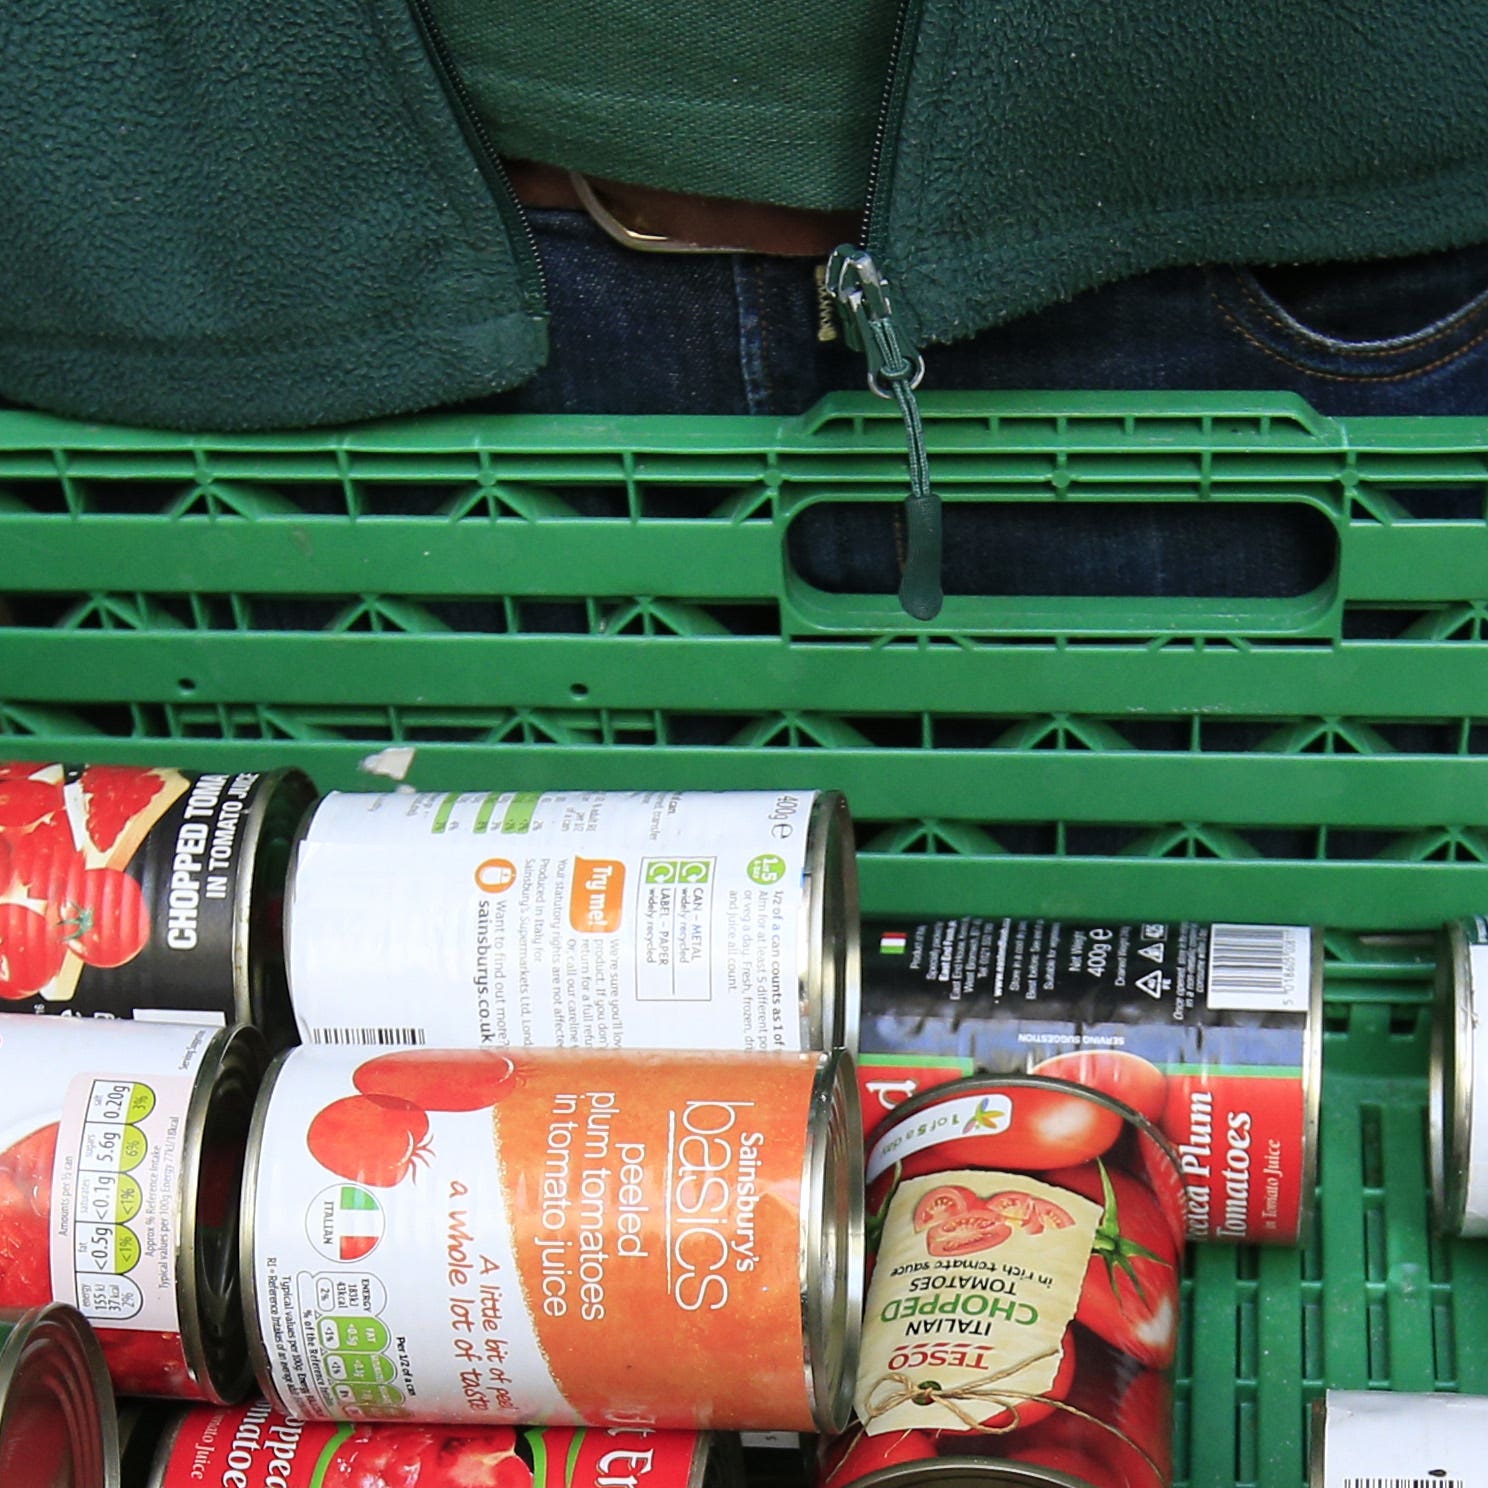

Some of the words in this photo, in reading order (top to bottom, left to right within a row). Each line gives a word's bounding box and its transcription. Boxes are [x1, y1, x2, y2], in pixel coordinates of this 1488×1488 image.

[227, 773, 260, 799] JUICE
[209, 801, 243, 871] TOMATO
[167, 822, 209, 949] CHOPPED
[206, 877, 227, 898] IN
[536, 858, 549, 902] Produced
[586, 866, 613, 889] Try
[495, 901, 507, 930] Want
[587, 893, 610, 925] me!
[645, 888, 656, 917] widely
[659, 887, 670, 917] LABEL
[678, 888, 690, 917] widely
[692, 887, 703, 911] CAN
[519, 917, 531, 993] Supermarkets
[646, 922, 656, 963] recycled
[659, 931, 669, 965] PAPER
[679, 922, 690, 963] recycled
[691, 925, 702, 960] METAL
[1087, 942, 1111, 977] 400g
[474, 900, 495, 1043] sainsburys.co.uk
[495, 953, 507, 978] find
[741, 961, 753, 994] Fresh,
[771, 961, 782, 1004] counts
[496, 1006, 509, 1045] more?
[568, 1000, 579, 1041] careline
[742, 997, 753, 1033] frozen,
[758, 985, 769, 1032] different
[103, 1085, 130, 1119] 0.20g
[553, 1094, 584, 1113] in
[584, 1092, 620, 1158] plum
[1179, 1092, 1212, 1177] Plum
[97, 1132, 120, 1161] 5.6g
[1263, 1139, 1283, 1177] Juice
[450, 1180, 468, 1198] a
[541, 1122, 578, 1229] tomato
[1216, 1112, 1251, 1237] Tomatoes
[93, 1176, 115, 1219] <0.1g
[121, 1189, 135, 1214] <1%
[146, 1174, 158, 1214] Reference
[615, 1143, 649, 1256] peeled
[674, 1101, 755, 1311] basics
[731, 1132, 764, 1272] Sainsbury's
[1262, 1178, 1278, 1217] Tomato
[59, 1198, 70, 1236] Amounts
[322, 1201, 334, 1244] ITALIAN
[92, 1227, 111, 1270] <0.5g
[448, 1210, 474, 1286] whole
[579, 1168, 612, 1320] tomatoes
[479, 1255, 500, 1274] A
[534, 1237, 572, 1316] juice
[890, 1261, 930, 1277] sauce
[934, 1260, 997, 1272] tomato
[1002, 1264, 1033, 1280] rich
[267, 1275, 279, 1314] Reference
[280, 1276, 293, 1309] Typical
[362, 1279, 370, 1312] ENERGY
[909, 1275, 1017, 1296] TOMATOES
[284, 1312, 295, 1338] values
[450, 1298, 475, 1330] lot
[480, 1285, 502, 1330] little
[881, 1293, 1038, 1325] CHOPPED
[305, 1322, 314, 1330] of
[906, 1318, 992, 1336] ITALIAN
[309, 1349, 325, 1384] Reference
[454, 1339, 482, 1361] of
[485, 1339, 508, 1361] bit
[888, 1350, 988, 1370] TESCO
[460, 1368, 489, 1411] taste
[490, 1368, 512, 1382] of
[190, 1445, 216, 1480] Juice
